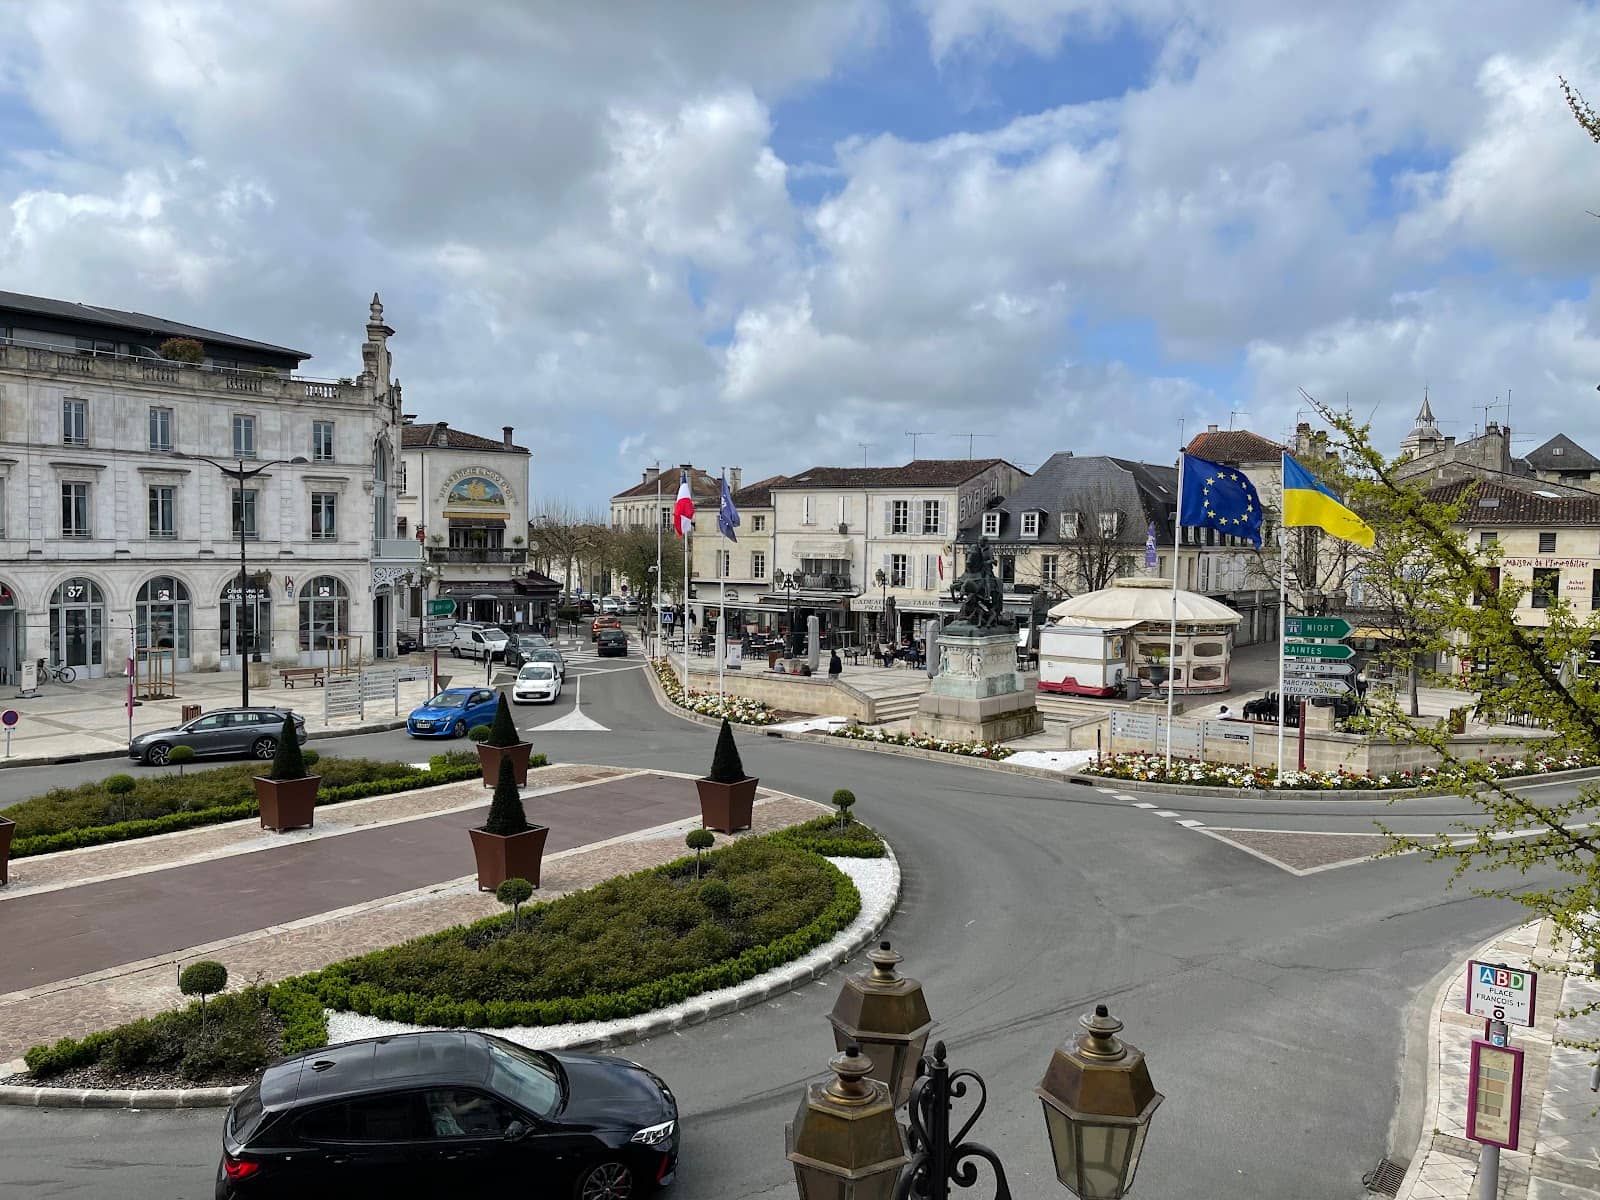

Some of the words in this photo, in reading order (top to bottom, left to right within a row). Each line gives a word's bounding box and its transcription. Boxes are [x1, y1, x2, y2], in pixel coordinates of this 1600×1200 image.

[67, 585, 84, 598] 37
[1306, 624, 1335, 632] NIORT
[1284, 646, 1322, 654] SAINTES
[1489, 987, 1514, 998] PLACE
